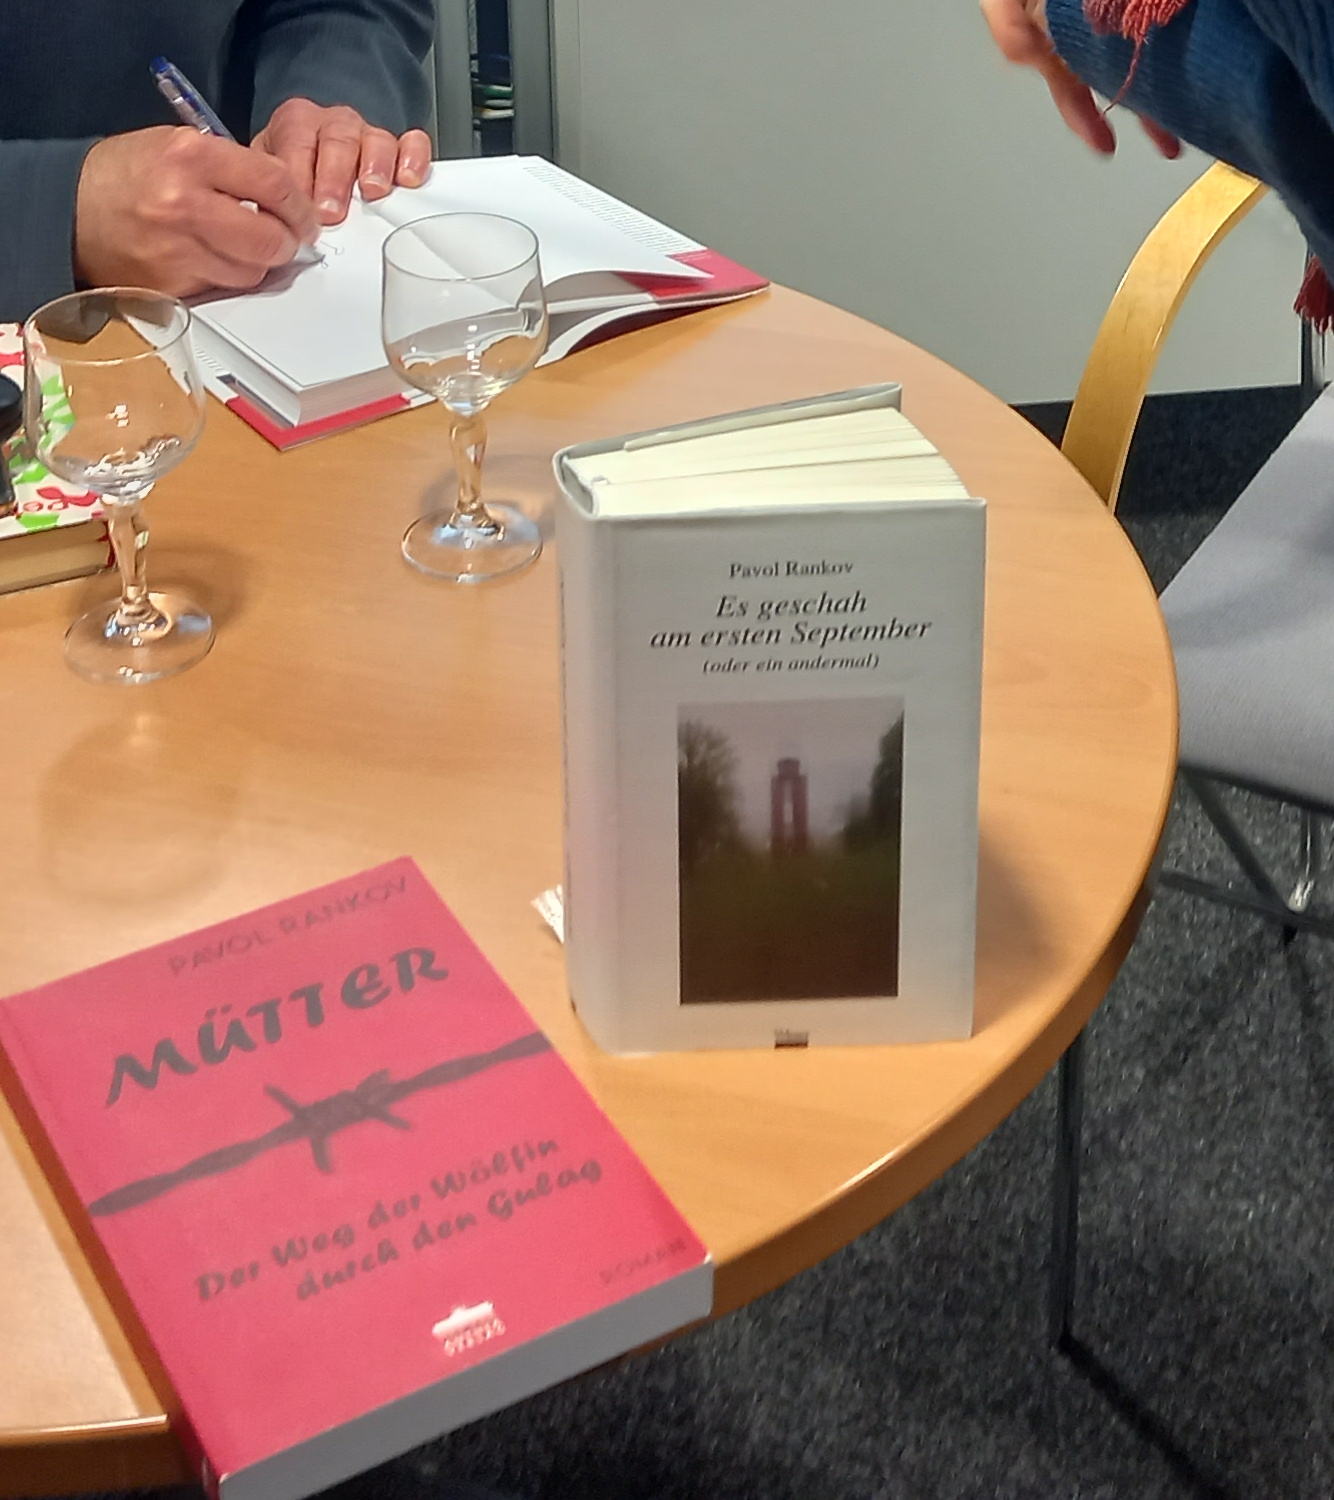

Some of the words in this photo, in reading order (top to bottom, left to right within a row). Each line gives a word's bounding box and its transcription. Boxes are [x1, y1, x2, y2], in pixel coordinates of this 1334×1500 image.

[729, 561, 779, 579] Pavol
[785, 560, 853, 576] Rankov
[650, 630, 691, 648] am
[700, 625, 782, 647] ersten
[790, 618, 932, 648] September
[716, 594, 748, 619] Es
[757, 590, 867, 621] geschah
[703, 657, 750, 676] (oder
[756, 658, 782, 673] ein
[787, 653, 879, 671] andermal)
[168, 931, 273, 976] PAVOL
[277, 875, 408, 934] RANKOV
[105, 946, 450, 1109] MÜTTER
[196, 1261, 261, 1301] Der
[272, 1224, 355, 1267] Weg
[368, 1193, 421, 1230] der
[430, 1138, 559, 1199] Wölfin
[296, 1238, 400, 1300] durch
[412, 1210, 477, 1251] den
[487, 1159, 603, 1220] Gulag
